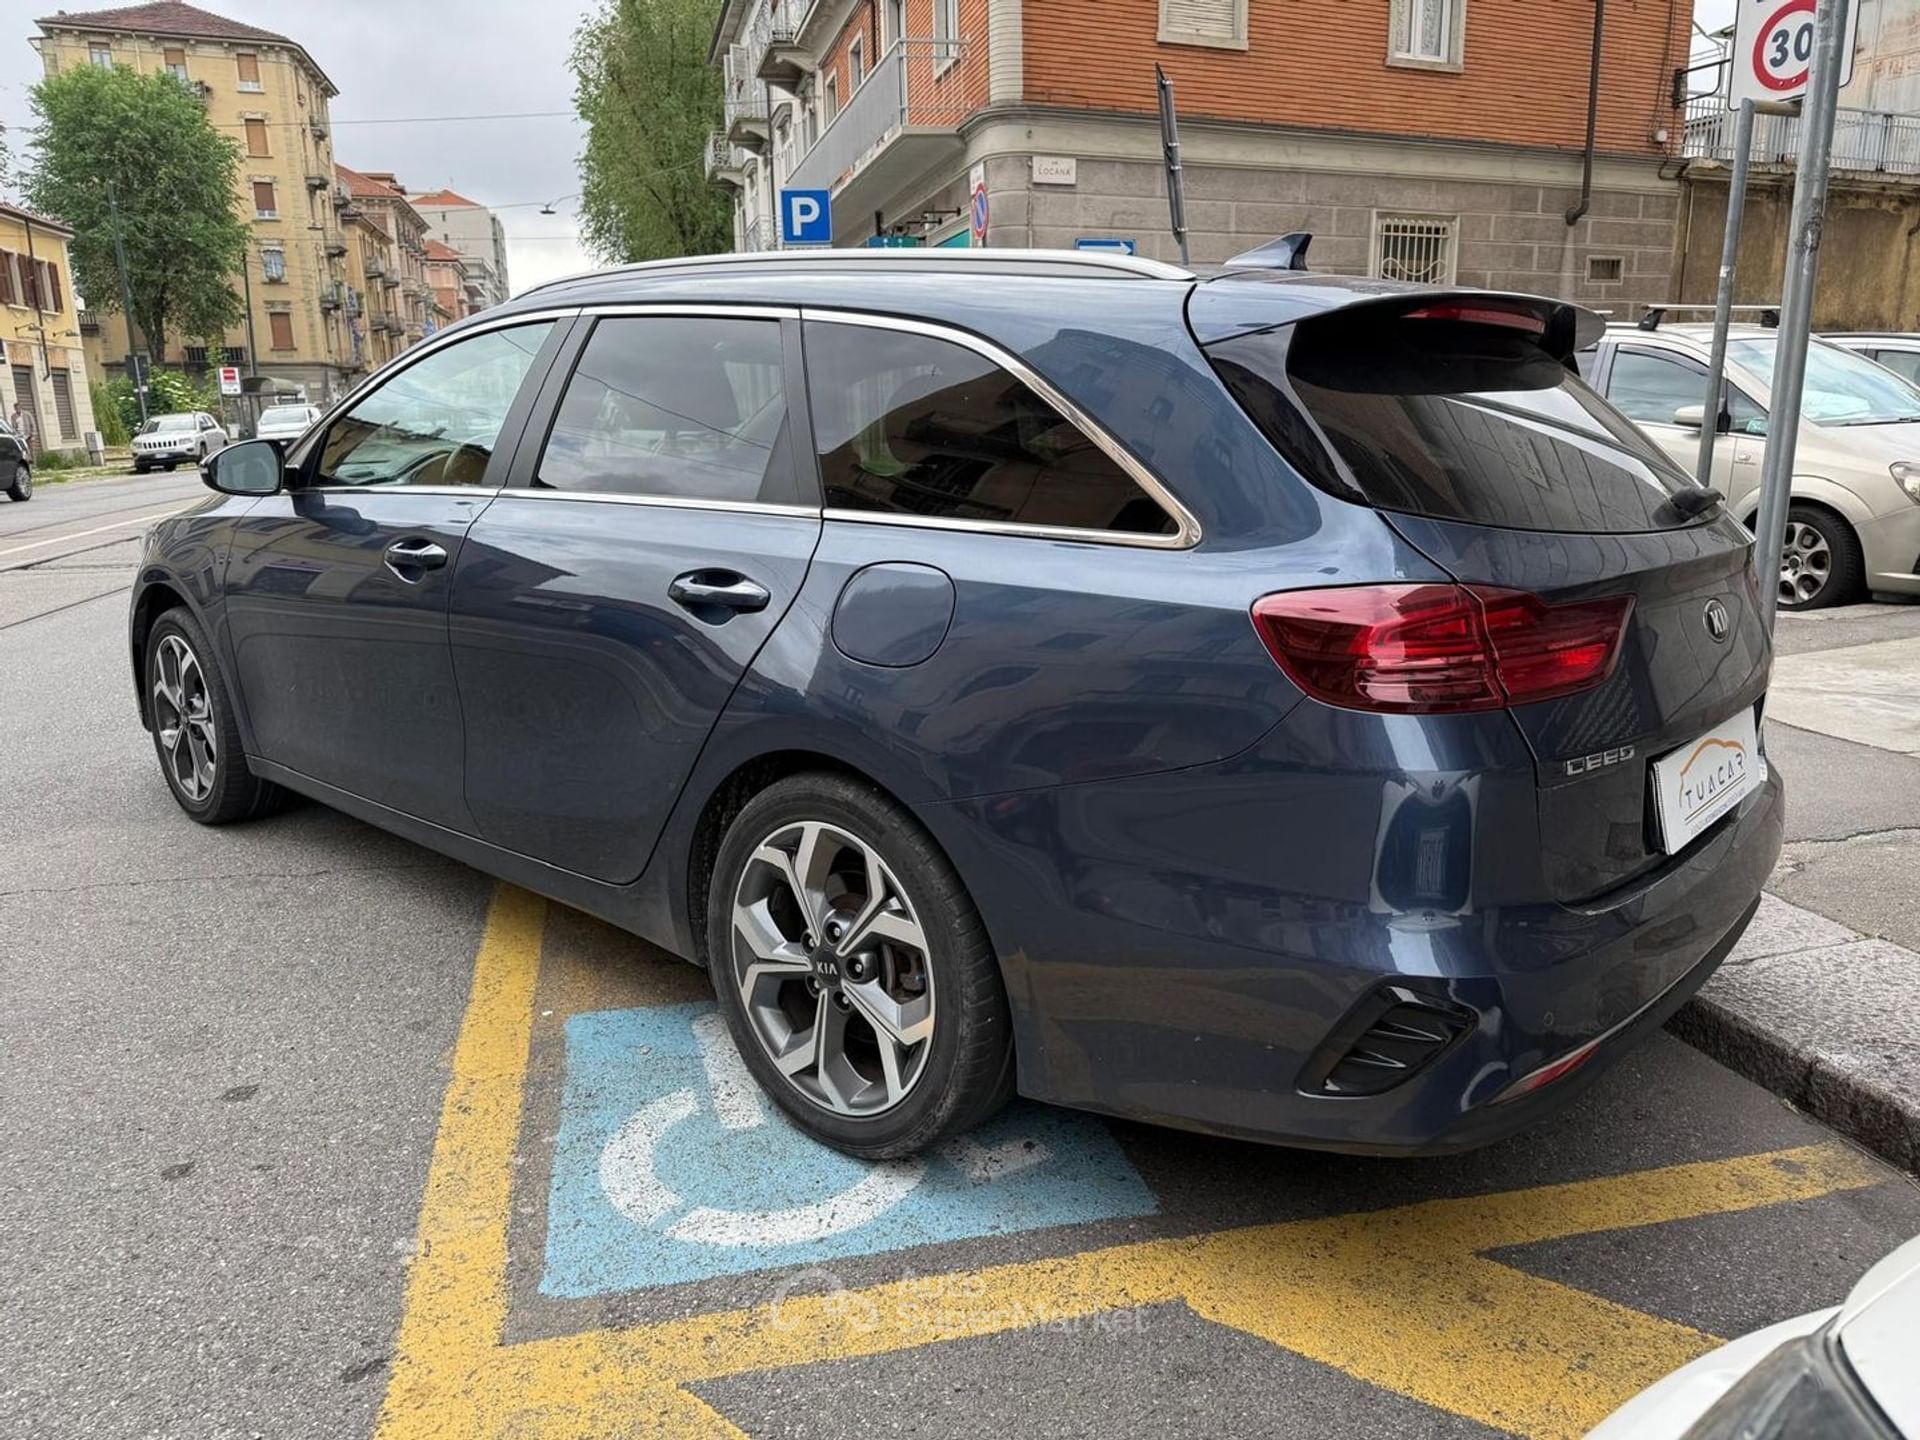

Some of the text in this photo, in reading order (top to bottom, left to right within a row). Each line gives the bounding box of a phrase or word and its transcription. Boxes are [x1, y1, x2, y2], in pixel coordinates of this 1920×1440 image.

[1769, 22, 1814, 68] 30
[1038, 167, 1071, 176] LOCANA
[791, 196, 820, 236] P
[1685, 752, 1745, 809] TUACAR
[816, 961, 838, 975] KIA
